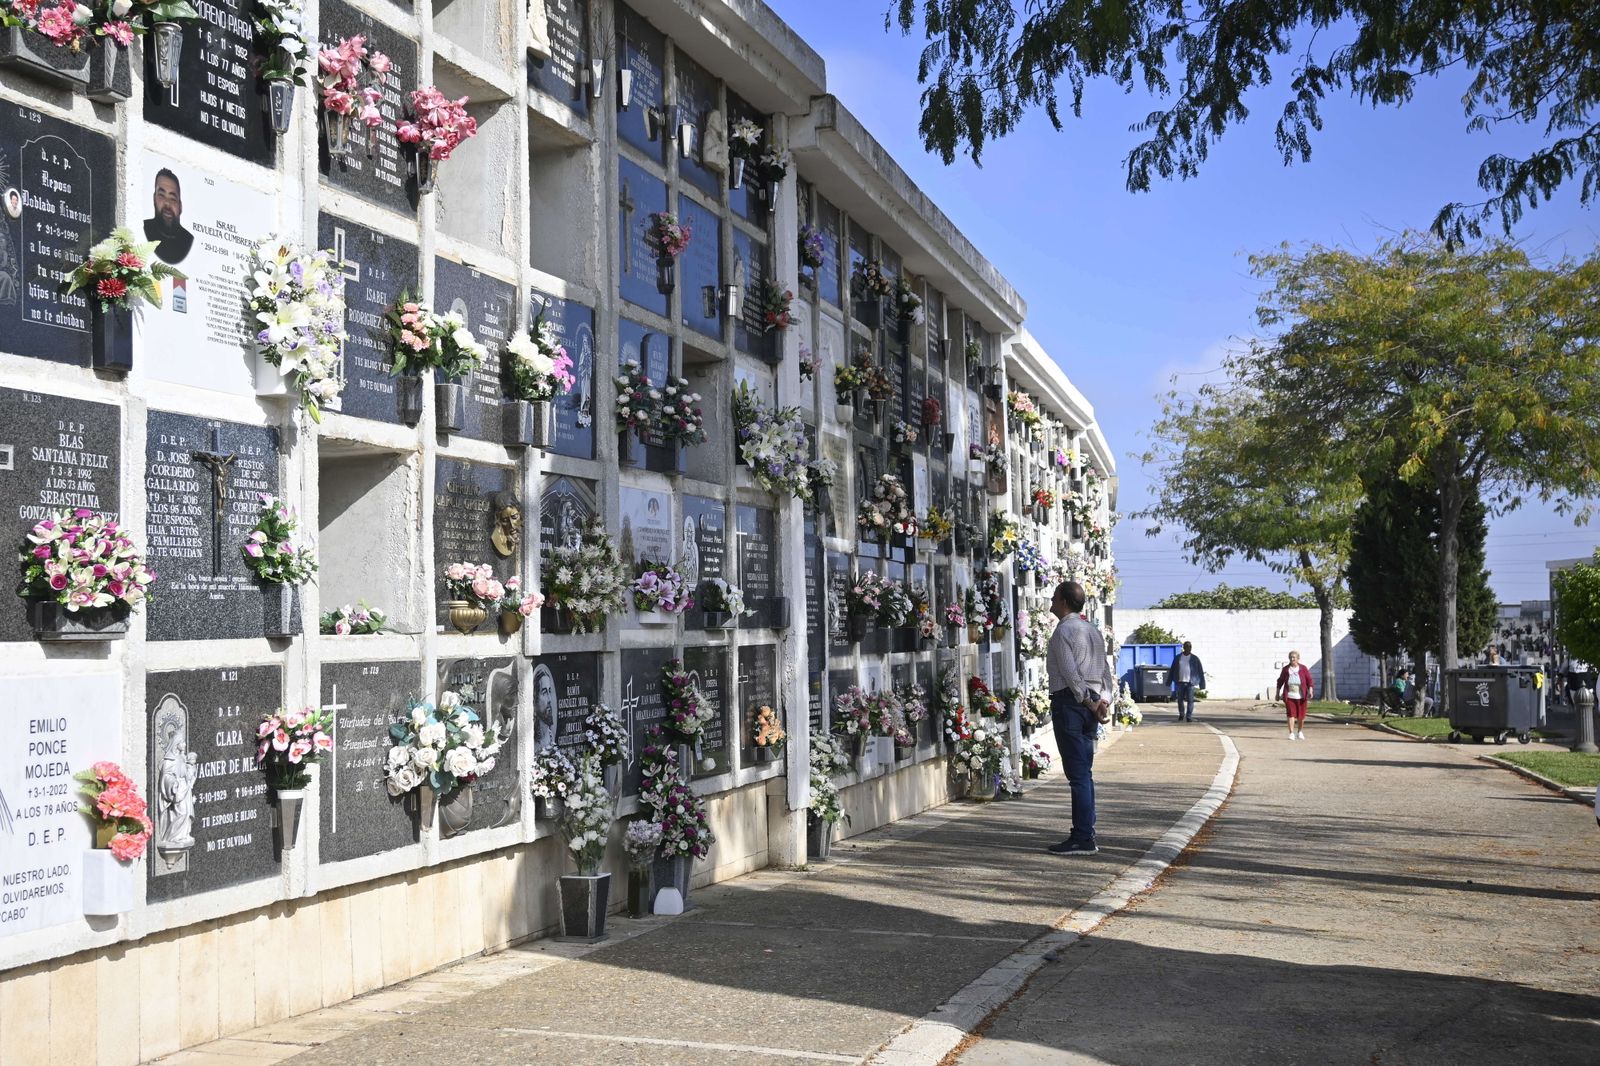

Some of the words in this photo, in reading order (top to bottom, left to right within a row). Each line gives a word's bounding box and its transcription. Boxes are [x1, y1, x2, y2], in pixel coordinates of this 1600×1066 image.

[228, 14, 253, 42] PARRA
[207, 31, 212, 44] 6
[220, 38, 226, 50] 11
[234, 44, 248, 60] 1992
[200, 48, 204, 61] A
[207, 51, 219, 68] LOS
[222, 58, 229, 72] 77
[232, 62, 246, 80] AÑOS
[208, 72, 216, 86] TU
[218, 76, 240, 96] ESPOSA
[200, 90, 218, 108] HIJOS
[219, 98, 224, 110] Y
[226, 101, 246, 120] NIETOS
[200, 110, 209, 124] NO
[211, 114, 219, 129] TE
[42, 147, 49, 162] d.
[63, 158, 72, 170] p.
[42, 170, 72, 194] Reposo
[22, 189, 56, 214] Doblado
[45, 224, 79, 242] 31-8-1992
[216, 220, 238, 234] ISRAEL
[193, 222, 223, 239] REVUELTA
[224, 232, 262, 251] CUMBRERAS
[30, 242, 35, 253] a
[38, 241, 51, 257] los
[65, 250, 83, 264] años
[37, 264, 47, 278] tu
[28, 282, 49, 300] hijos
[61, 293, 86, 308] nietos
[366, 287, 388, 306] ISABEL
[31, 308, 42, 320] no
[44, 309, 53, 322] te
[56, 312, 85, 329] olvidan
[349, 308, 382, 329] RODRIGUEZ
[360, 379, 366, 388] NO
[373, 382, 393, 394] OLVIDAN
[58, 420, 66, 431] D.
[69, 422, 76, 433] E.
[59, 433, 84, 450] BLAS
[161, 434, 168, 444] D.
[170, 436, 177, 446] E.
[32, 446, 78, 466] SANTANA
[80, 452, 108, 469] FELIX
[157, 450, 166, 462] D.
[168, 449, 190, 465] JOSÉ
[238, 460, 264, 470] RESTOS
[58, 466, 63, 476] 3
[67, 467, 72, 477] 8
[78, 468, 92, 480] 1992
[151, 464, 195, 479] CORDERO
[241, 470, 249, 479] DE
[46, 478, 52, 489] A
[53, 478, 67, 490] LOS
[68, 480, 76, 491] 73
[77, 480, 96, 493] AÑOS
[146, 478, 200, 492] GALLARDO
[234, 479, 268, 490] HERMANO
[40, 490, 100, 509] SEBASTIANA
[154, 493, 160, 502] 9
[153, 503, 169, 513] LOS
[182, 503, 202, 516] AÑOS
[151, 514, 164, 524] TU
[170, 526, 199, 537] NIETOS
[153, 536, 202, 547] FAMILIARES
[157, 548, 168, 557] TE
[169, 548, 203, 558] OLVIDAN
[229, 671, 238, 681] 121
[218, 707, 225, 718] D.
[227, 706, 233, 717] E.
[235, 705, 241, 716] P.
[29, 717, 67, 734] EMILIO
[216, 730, 243, 747] CLARA
[29, 740, 67, 756] PONCE
[25, 761, 70, 780] MOJEDA
[229, 758, 240, 774] DE
[34, 783, 68, 798] 3-1-2022
[199, 790, 227, 804] 3-10-1929
[16, 808, 22, 820] A
[24, 806, 41, 818] LOS
[44, 804, 53, 816] 78
[55, 800, 78, 814] AÑOS
[202, 817, 211, 828] TU
[212, 814, 234, 827] ESPOSO
[235, 812, 239, 823] E
[240, 808, 257, 821] HIJOS
[28, 831, 40, 846] D.
[43, 829, 53, 844] E.
[57, 827, 67, 842] P.
[207, 840, 216, 852] NO
[217, 838, 225, 850] TE
[226, 834, 252, 848] OLVIDAN
[3, 868, 44, 886] NUESTRO
[3, 882, 64, 905] OLVIDAREMOS
